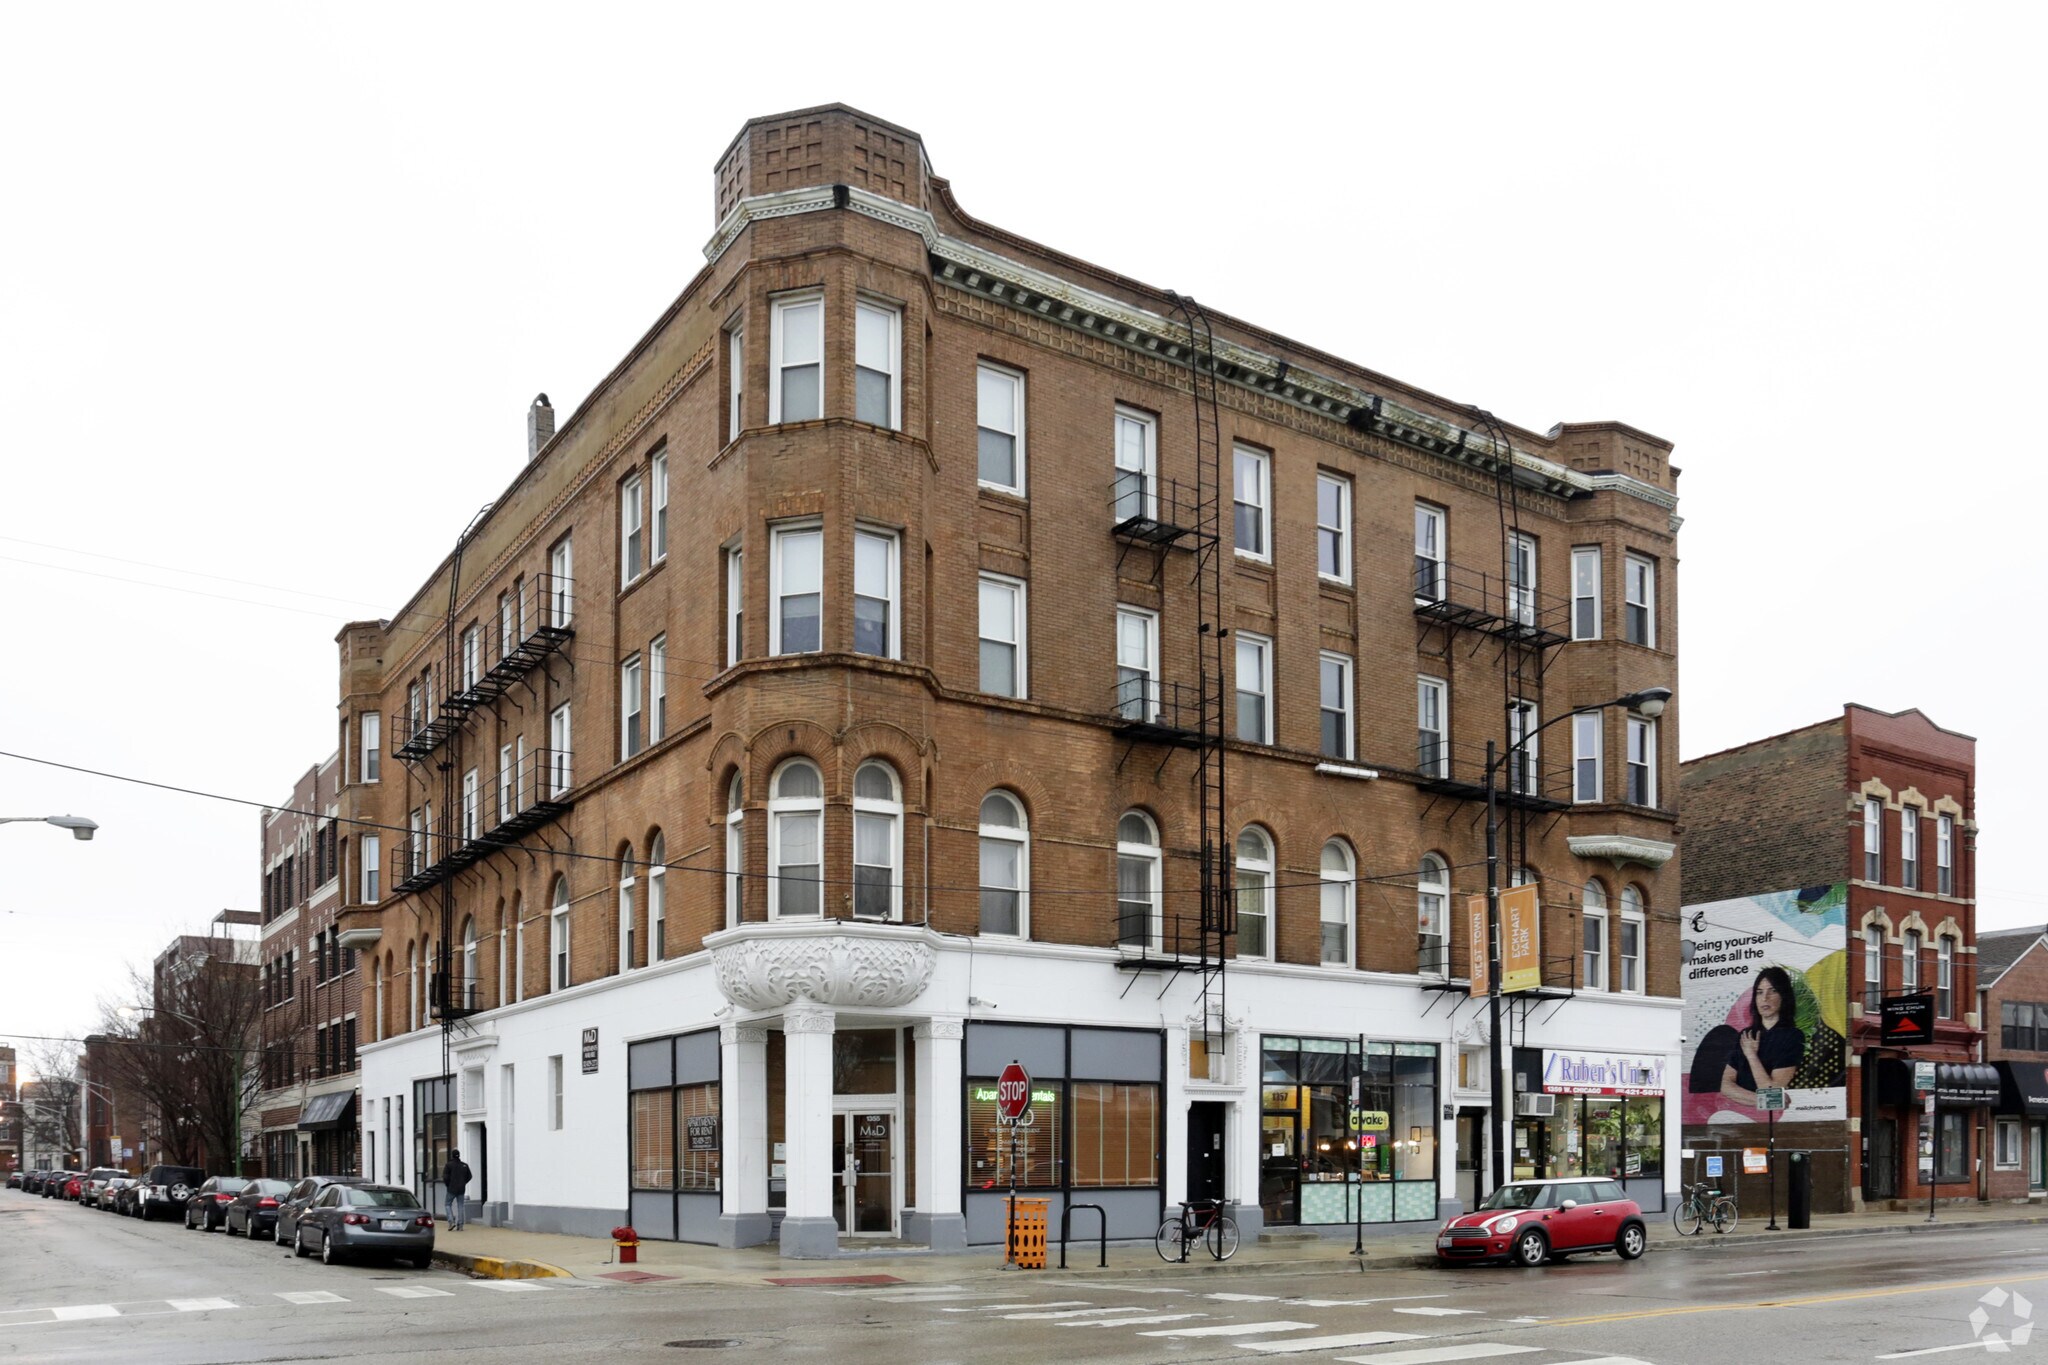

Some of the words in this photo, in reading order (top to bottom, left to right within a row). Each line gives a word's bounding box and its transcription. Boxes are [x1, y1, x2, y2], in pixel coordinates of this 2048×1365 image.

[1473, 913, 1482, 945] TOWN
[1511, 907, 1521, 958] ECKHART
[1520, 928, 1530, 957] PARK
[1724, 931, 1774, 950] yourself
[1474, 949, 1483, 979] WEST
[1689, 952, 1727, 967] makes
[1728, 949, 1742, 962] all
[1744, 948, 1764, 960] the
[1688, 965, 1749, 980] difference
[1560, 1055, 1617, 1083] Ruben's
[1000, 1081, 1026, 1101] STOP
[1272, 1092, 1289, 1101] 1357
[689, 1127, 700, 1136] FOR
[701, 1126, 713, 1135] RENT
[860, 1125, 886, 1136] M&D
